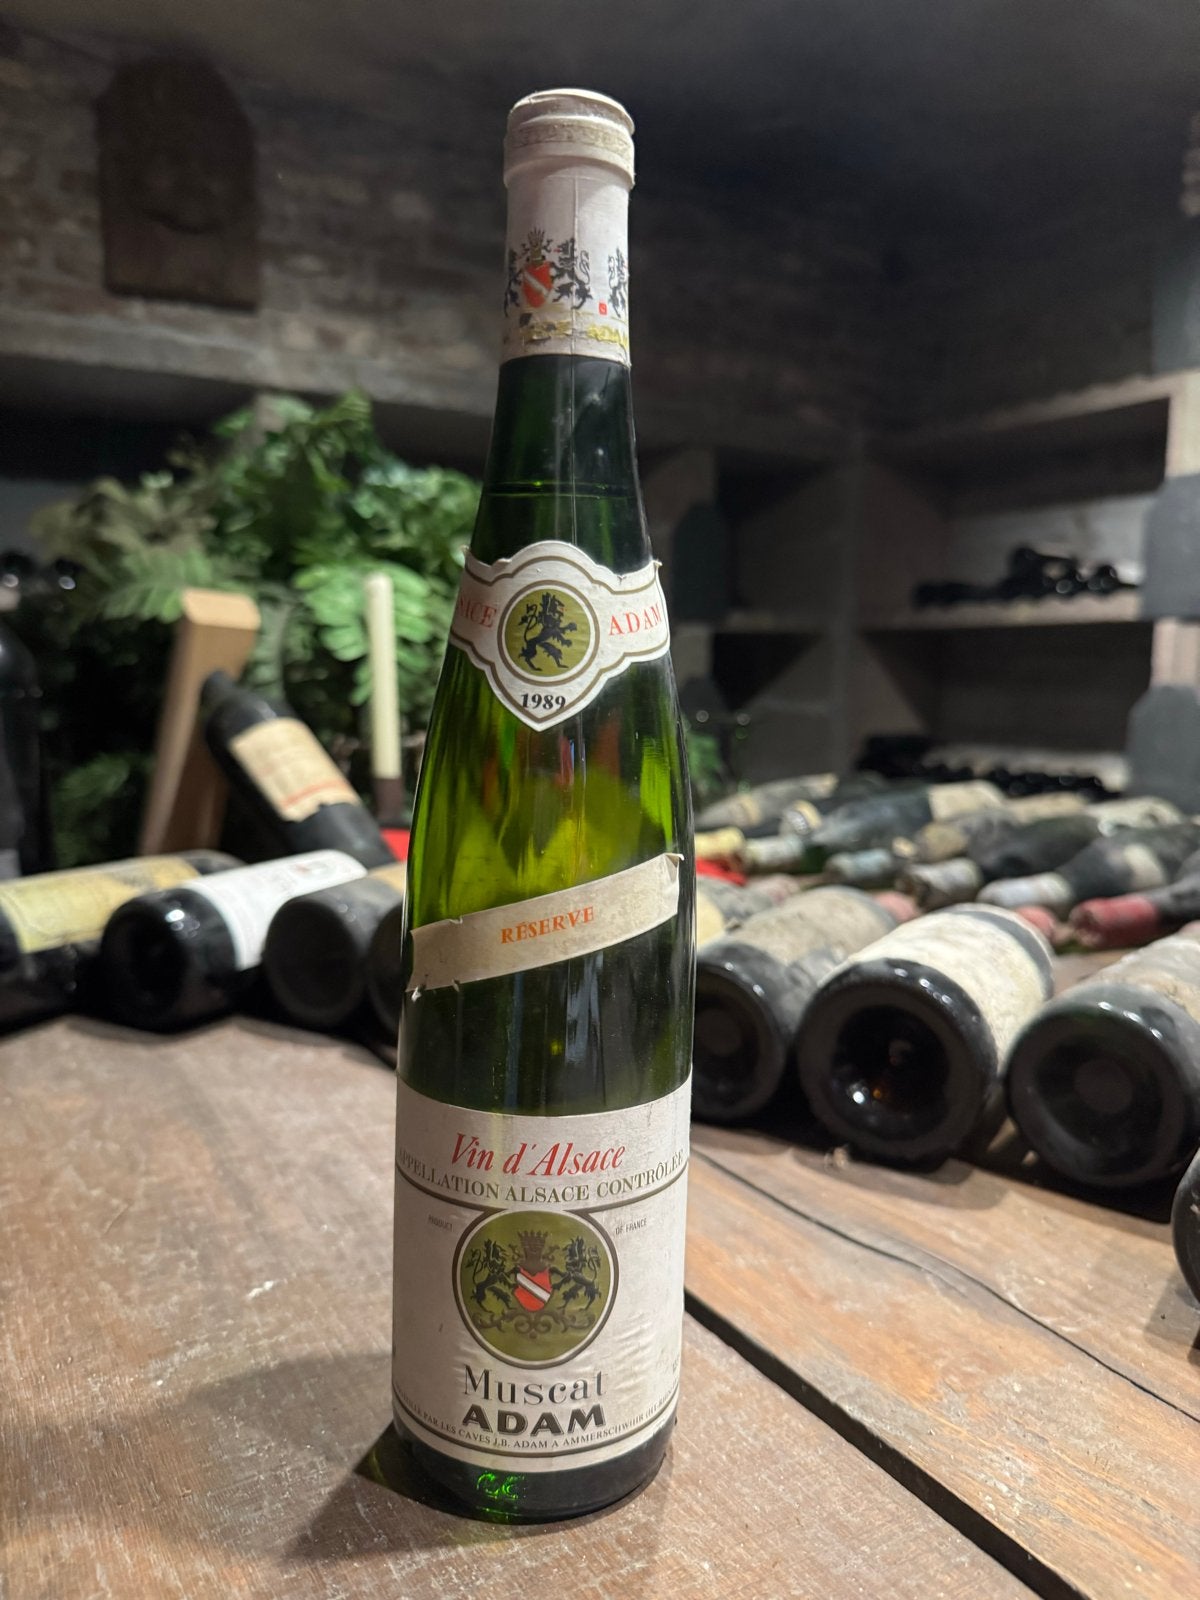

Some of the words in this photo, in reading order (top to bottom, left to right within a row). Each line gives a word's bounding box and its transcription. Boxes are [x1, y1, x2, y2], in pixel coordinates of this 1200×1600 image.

[608, 602, 663, 636] ADAM
[520, 694, 567, 711] 1989
[501, 906, 594, 944] RÉSERVE
[451, 1132, 495, 1172] Vin
[505, 1184, 590, 1204] ALSACE
[596, 1149, 684, 1198] CONTRÔLÉE
[626, 1217, 647, 1233] FRANCE
[464, 1363, 608, 1405] Muscat
[441, 1421, 456, 1434] LES
[459, 1429, 491, 1444] CAVES
[493, 1437, 510, 1448] J.B.
[513, 1440, 548, 1449] ADAM
[462, 1403, 606, 1437] ADAM
